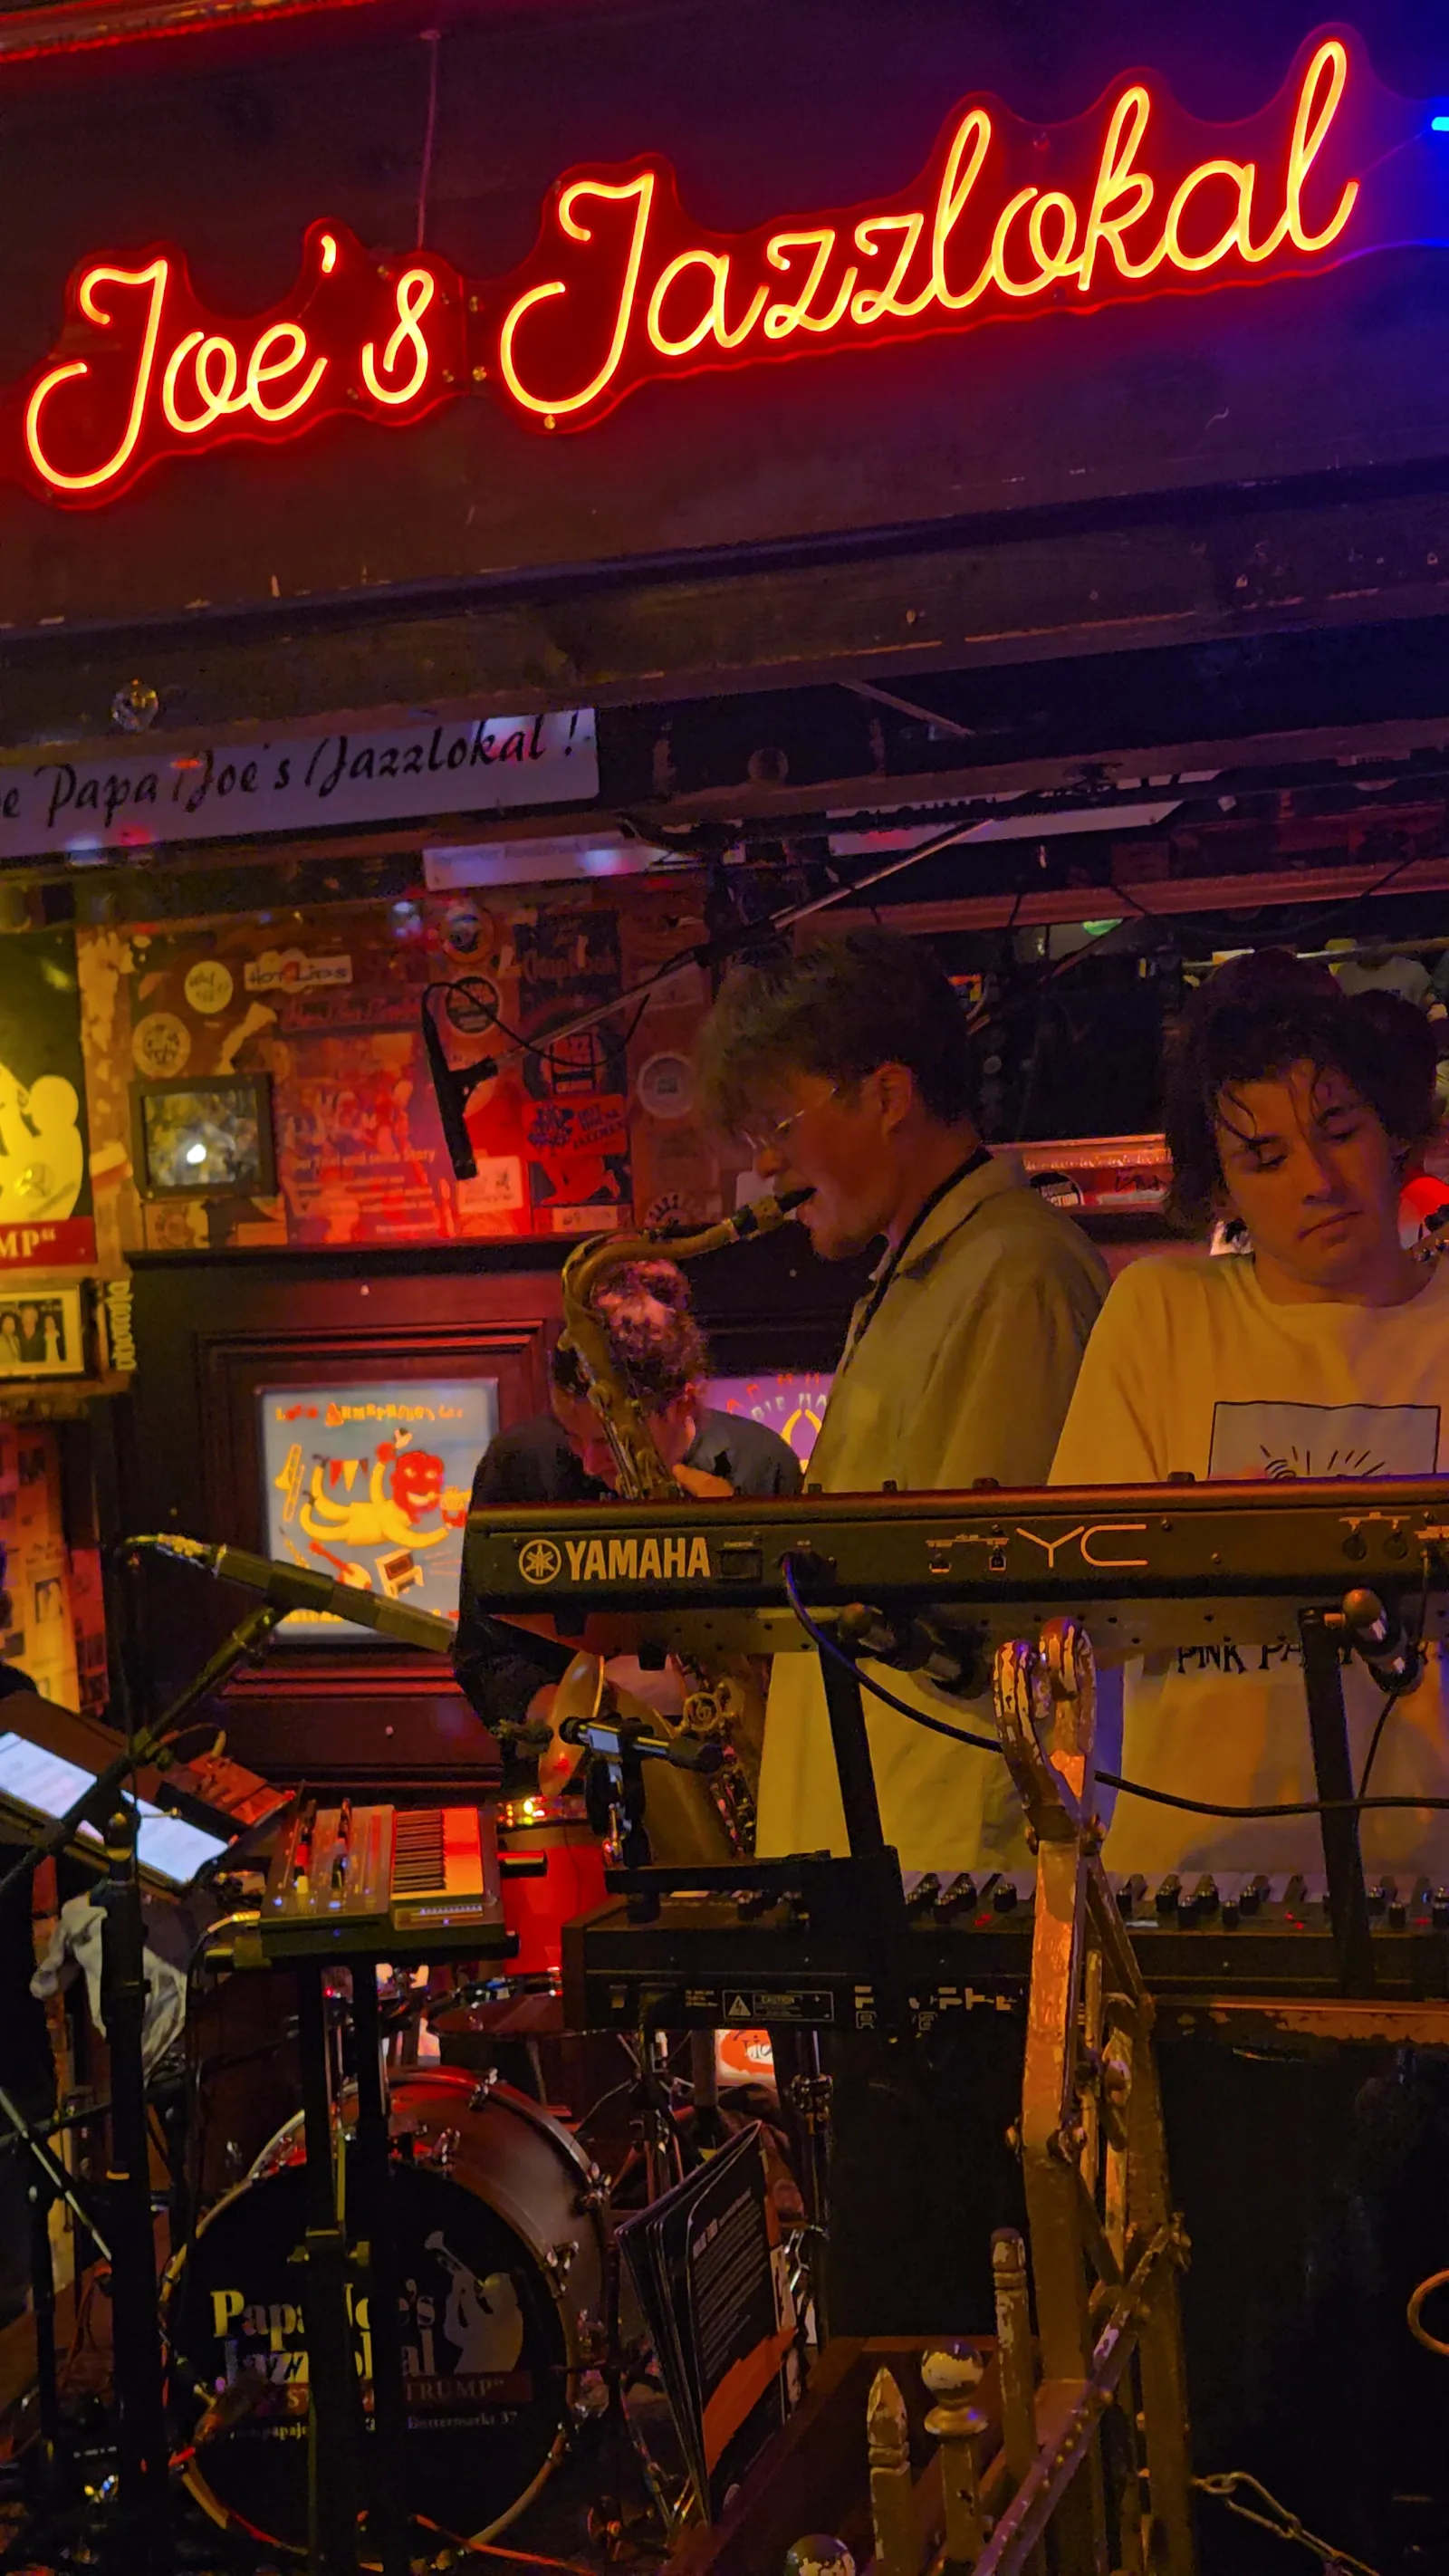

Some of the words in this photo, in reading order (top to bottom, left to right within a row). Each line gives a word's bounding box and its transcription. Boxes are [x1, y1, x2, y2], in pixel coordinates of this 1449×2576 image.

[25, 232, 442, 493] Joe's
[499, 38, 1359, 416] Jazzlokal
[34, 763, 158, 829] Papa
[304, 712, 549, 798] Jazzlokal
[564, 1536, 711, 1581] YAMAHA
[1015, 1523, 1147, 1568] YC
